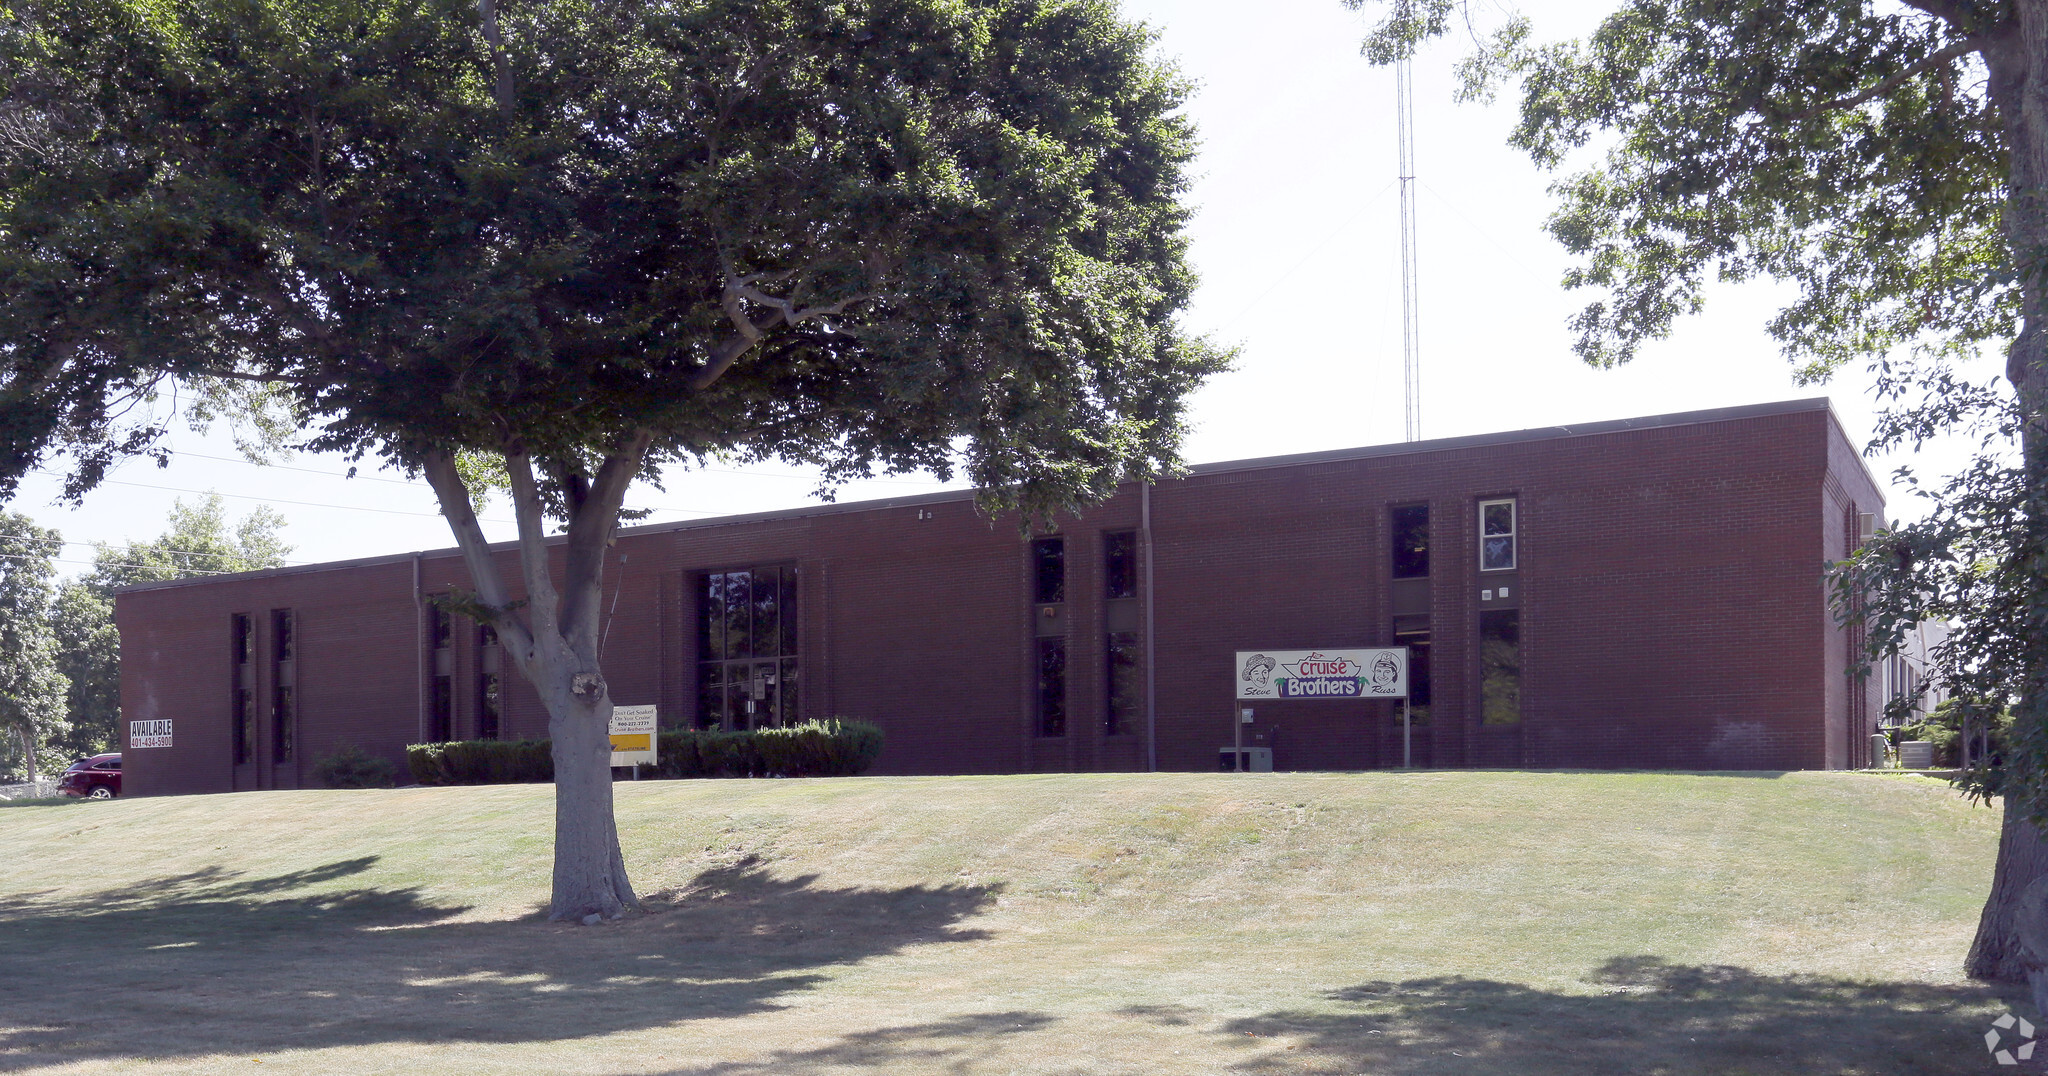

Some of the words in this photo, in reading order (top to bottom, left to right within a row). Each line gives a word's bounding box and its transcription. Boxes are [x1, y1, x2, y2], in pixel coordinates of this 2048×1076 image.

[1244, 687, 1271, 696] Steve
[1288, 678, 1356, 695] Brothers
[1371, 685, 1396, 694] Russ
[132, 721, 171, 736] AVAILABLE
[132, 737, 172, 747] 401-434-5900
